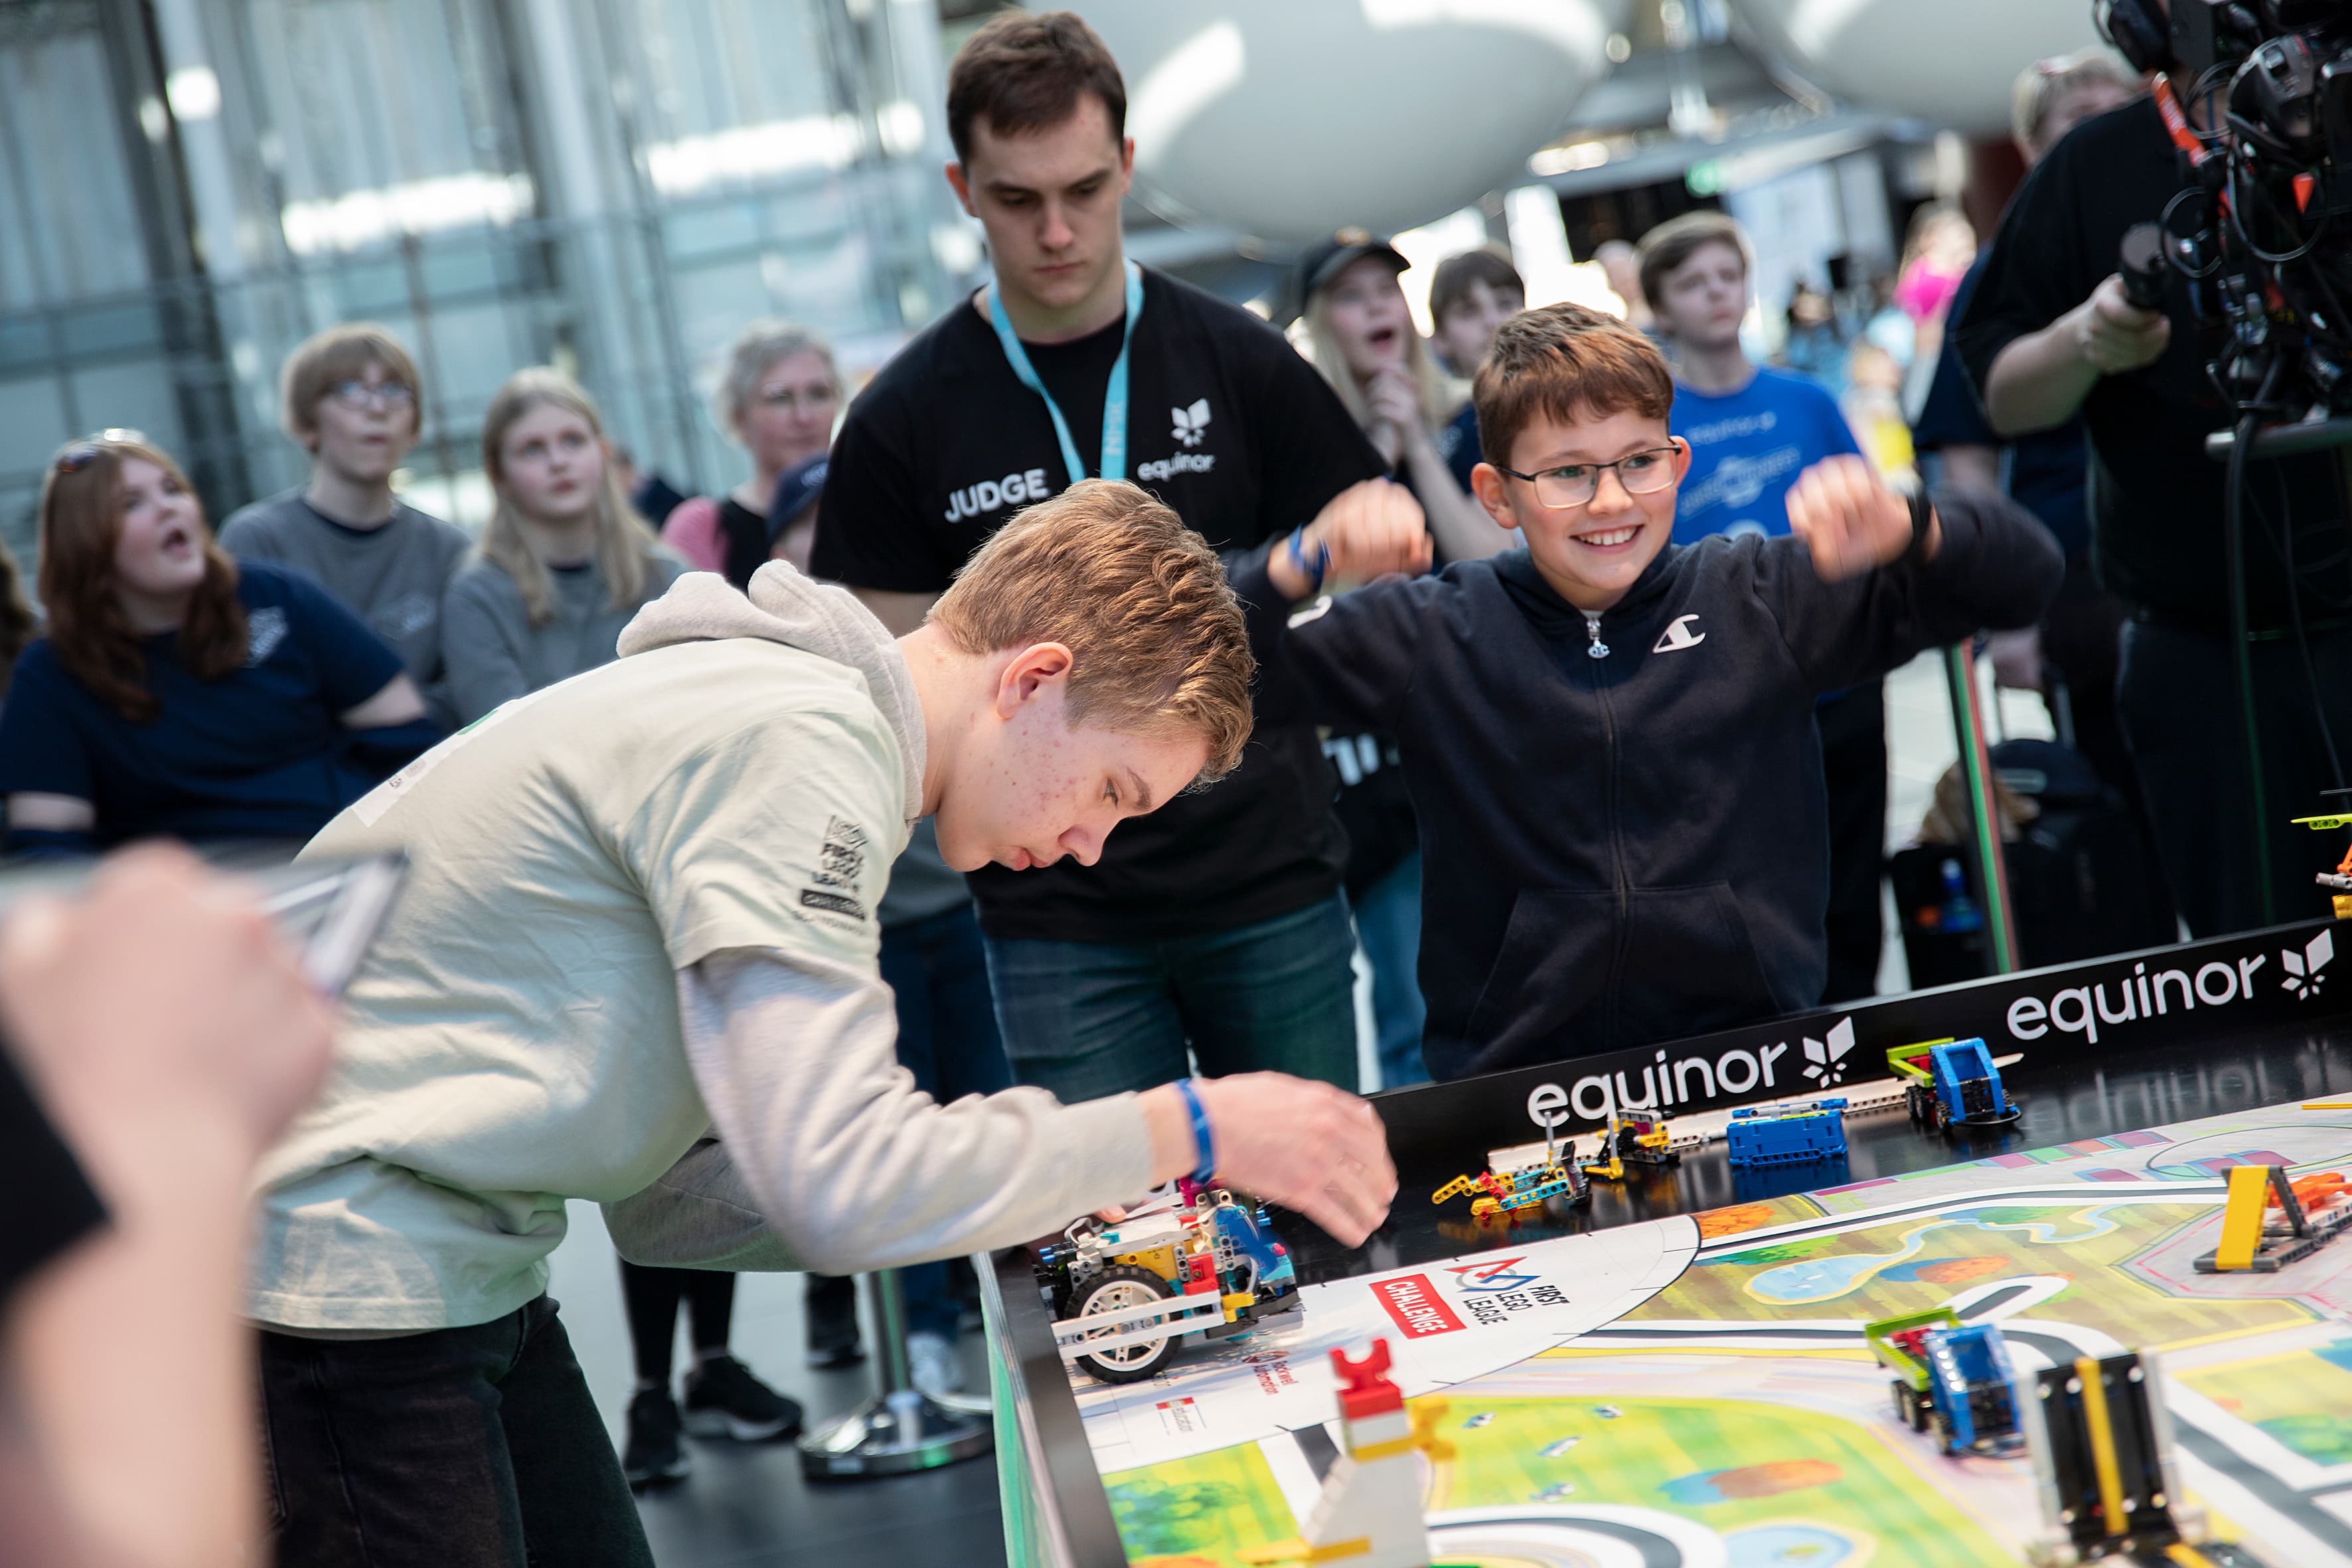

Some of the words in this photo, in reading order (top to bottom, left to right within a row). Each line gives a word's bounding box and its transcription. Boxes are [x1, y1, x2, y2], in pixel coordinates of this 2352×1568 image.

[1137, 451, 1217, 482] equinor
[944, 468, 1052, 524] JUDGE
[2006, 953, 2266, 1044] equinor
[1527, 1041, 1788, 1128] equinor
[1383, 1281, 1449, 1334] CHALLENGE
[1463, 1296, 1509, 1325] LEAGUE
[1495, 1290, 1533, 1311] LEGO
[1528, 1285, 1571, 1306] FIRST
